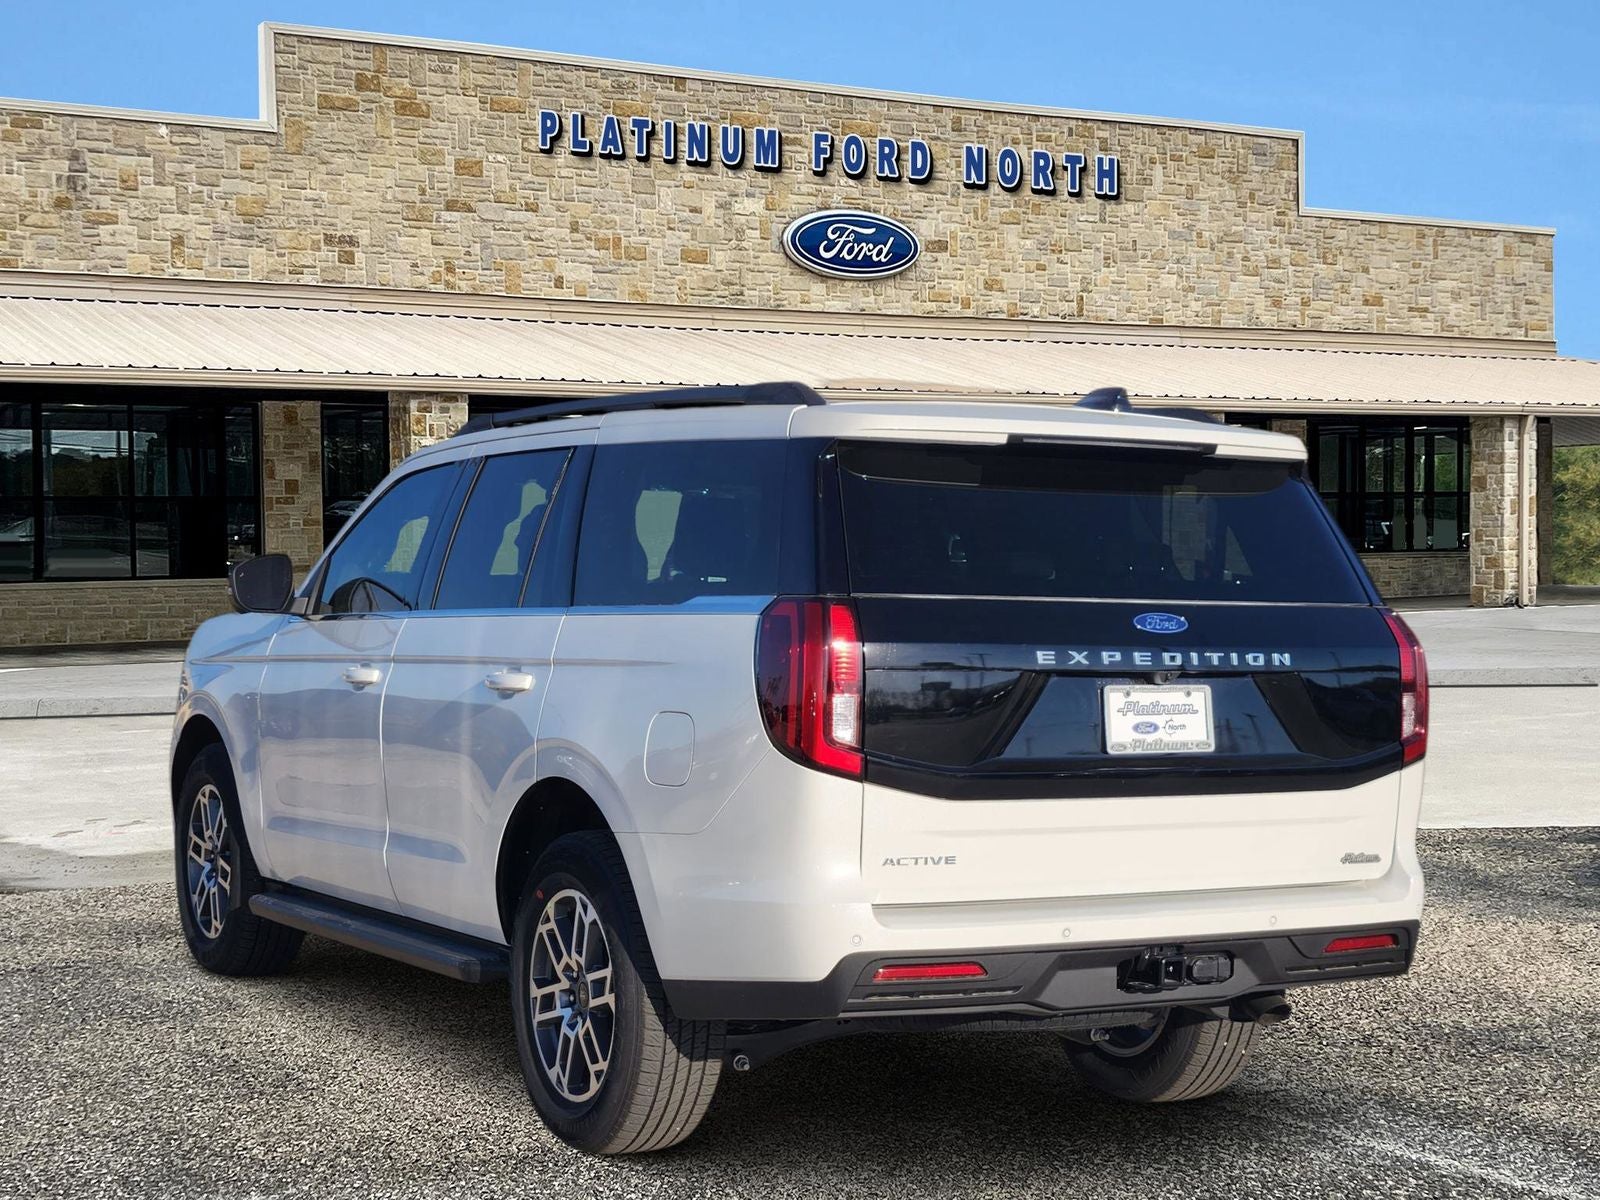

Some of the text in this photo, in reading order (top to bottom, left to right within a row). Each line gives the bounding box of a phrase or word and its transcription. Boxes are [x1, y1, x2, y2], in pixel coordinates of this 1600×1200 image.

[538, 109, 1121, 200] PLATINUM FORD NORTH
[819, 223, 895, 263] Ford
[1145, 615, 1179, 630] Ford
[1036, 650, 1292, 667] EXPEDITION
[1117, 700, 1199, 716] Platinum
[1168, 723, 1187, 731] North
[1130, 738, 1194, 751] Platinum
[882, 855, 957, 867] ACTIVE
